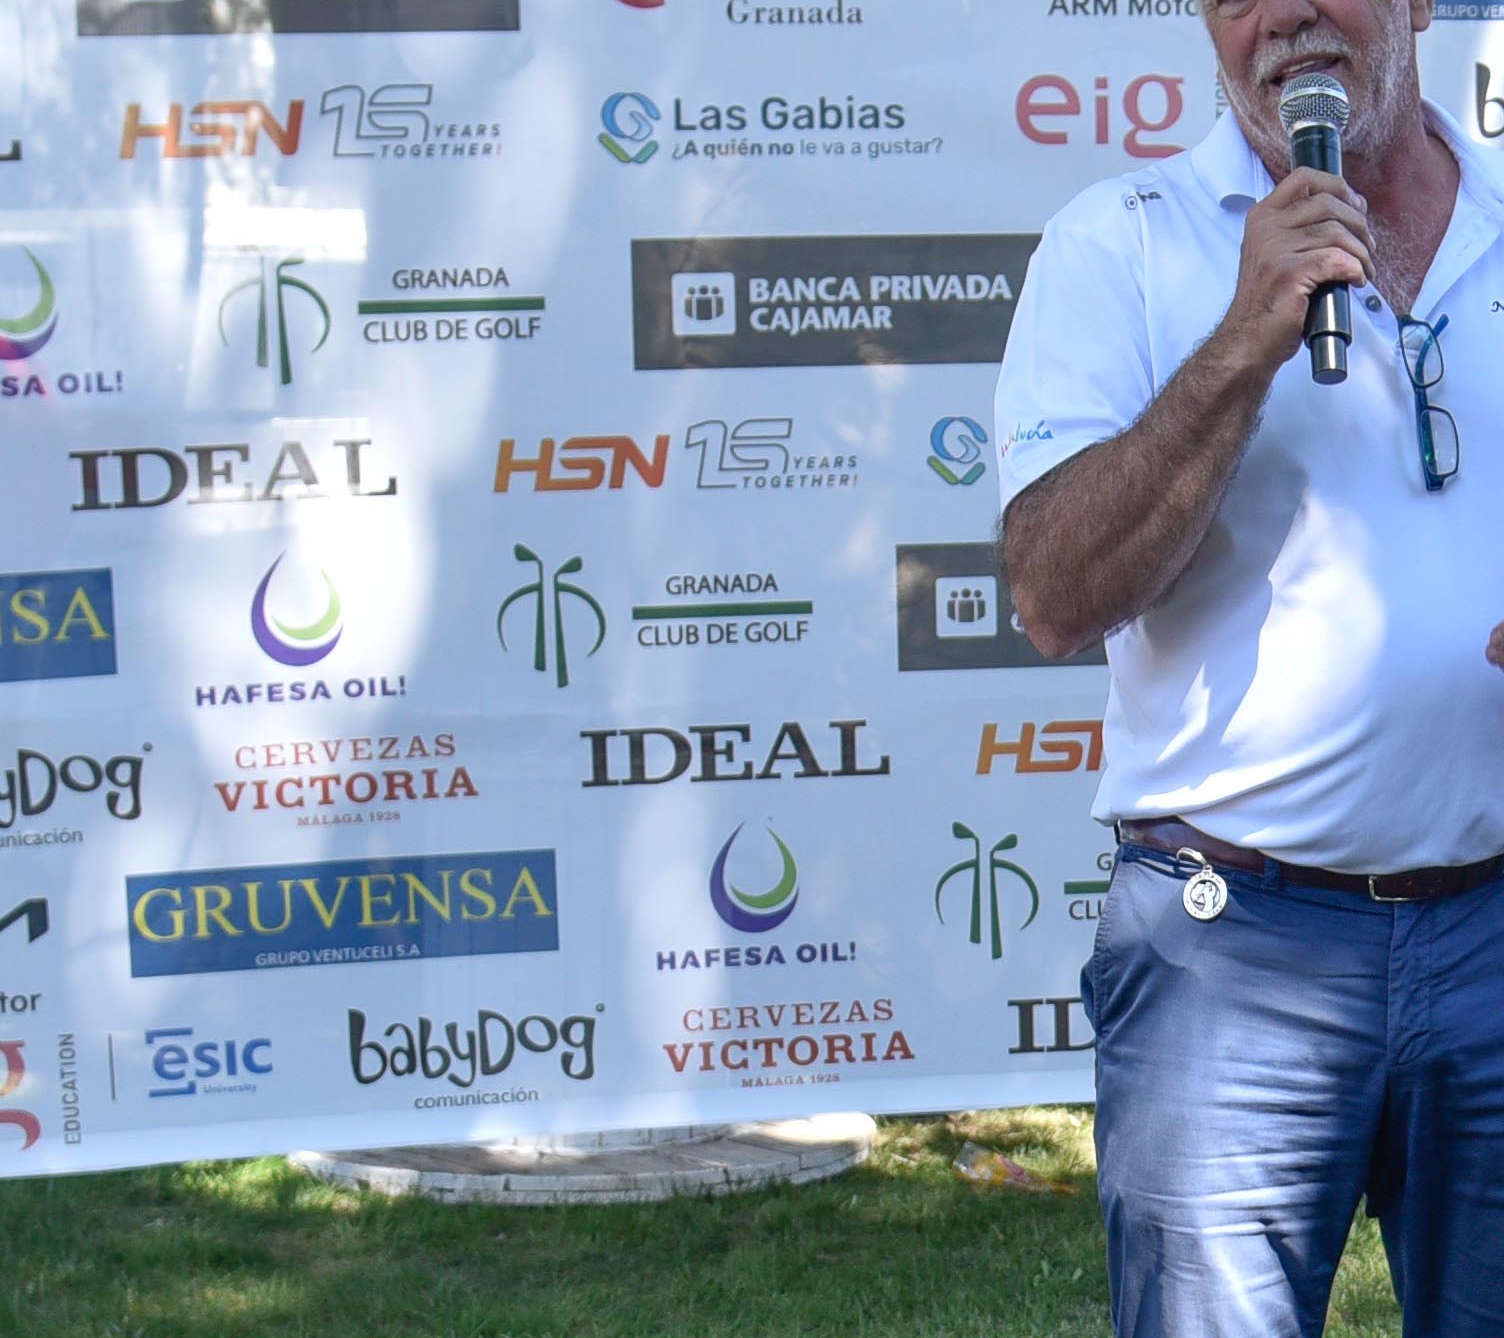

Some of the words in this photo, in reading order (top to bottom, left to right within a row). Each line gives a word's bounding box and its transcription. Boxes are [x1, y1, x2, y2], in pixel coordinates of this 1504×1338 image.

[118, 98, 306, 161] HSN
[433, 122, 502, 139] YEARS
[673, 97, 747, 133] Las
[760, 95, 907, 131] Gabias
[1014, 72, 1188, 160] eig
[380, 141, 502, 160] TOGETHER!
[671, 138, 699, 159] ¿A
[702, 135, 764, 161] quién
[767, 141, 795, 157] no
[799, 136, 818, 156] le
[822, 141, 848, 155] va
[851, 141, 864, 155] a
[867, 135, 945, 160] gustar?
[391, 266, 511, 292] GRANADA
[748, 275, 864, 304] BANCA
[869, 272, 1014, 302] PRIVADA
[362, 317, 430, 345] CLUB
[435, 317, 469, 342] DE
[474, 315, 543, 341] GOLF
[748, 304, 894, 336] CAJAMAR
[57, 370, 125, 396] OIL!
[68, 437, 398, 513] IDEAL
[492, 433, 671, 494] HSN
[793, 453, 859, 472] YEARS
[741, 472, 861, 491] TOGETHER!
[665, 572, 779, 596] GRANADA
[636, 621, 701, 647] CLUB
[706, 622, 739, 645] DE
[744, 619, 810, 645] GOLF
[195, 678, 331, 706] HAFESA
[343, 674, 408, 700] OIL!
[235, 733, 457, 770] CERVEZAS
[580, 719, 890, 789] IDEAL
[214, 766, 479, 812] VICTORIA
[297, 812, 364, 827] MÁLAGA
[132, 867, 555, 943] GRUVENSA
[256, 950, 310, 967] GRUPO
[312, 945, 394, 964] VENTUCELI
[656, 943, 786, 971] HAFESA
[796, 941, 857, 965] OIL!
[682, 997, 895, 1033] CERVEZAS
[347, 1008, 596, 1087] babyDog
[663, 1029, 915, 1074] VICTORIA
[63, 1032, 82, 1145] EDUCATION
[414, 1086, 539, 1110] comunicación
[741, 1076, 805, 1090] MÁLAGA
